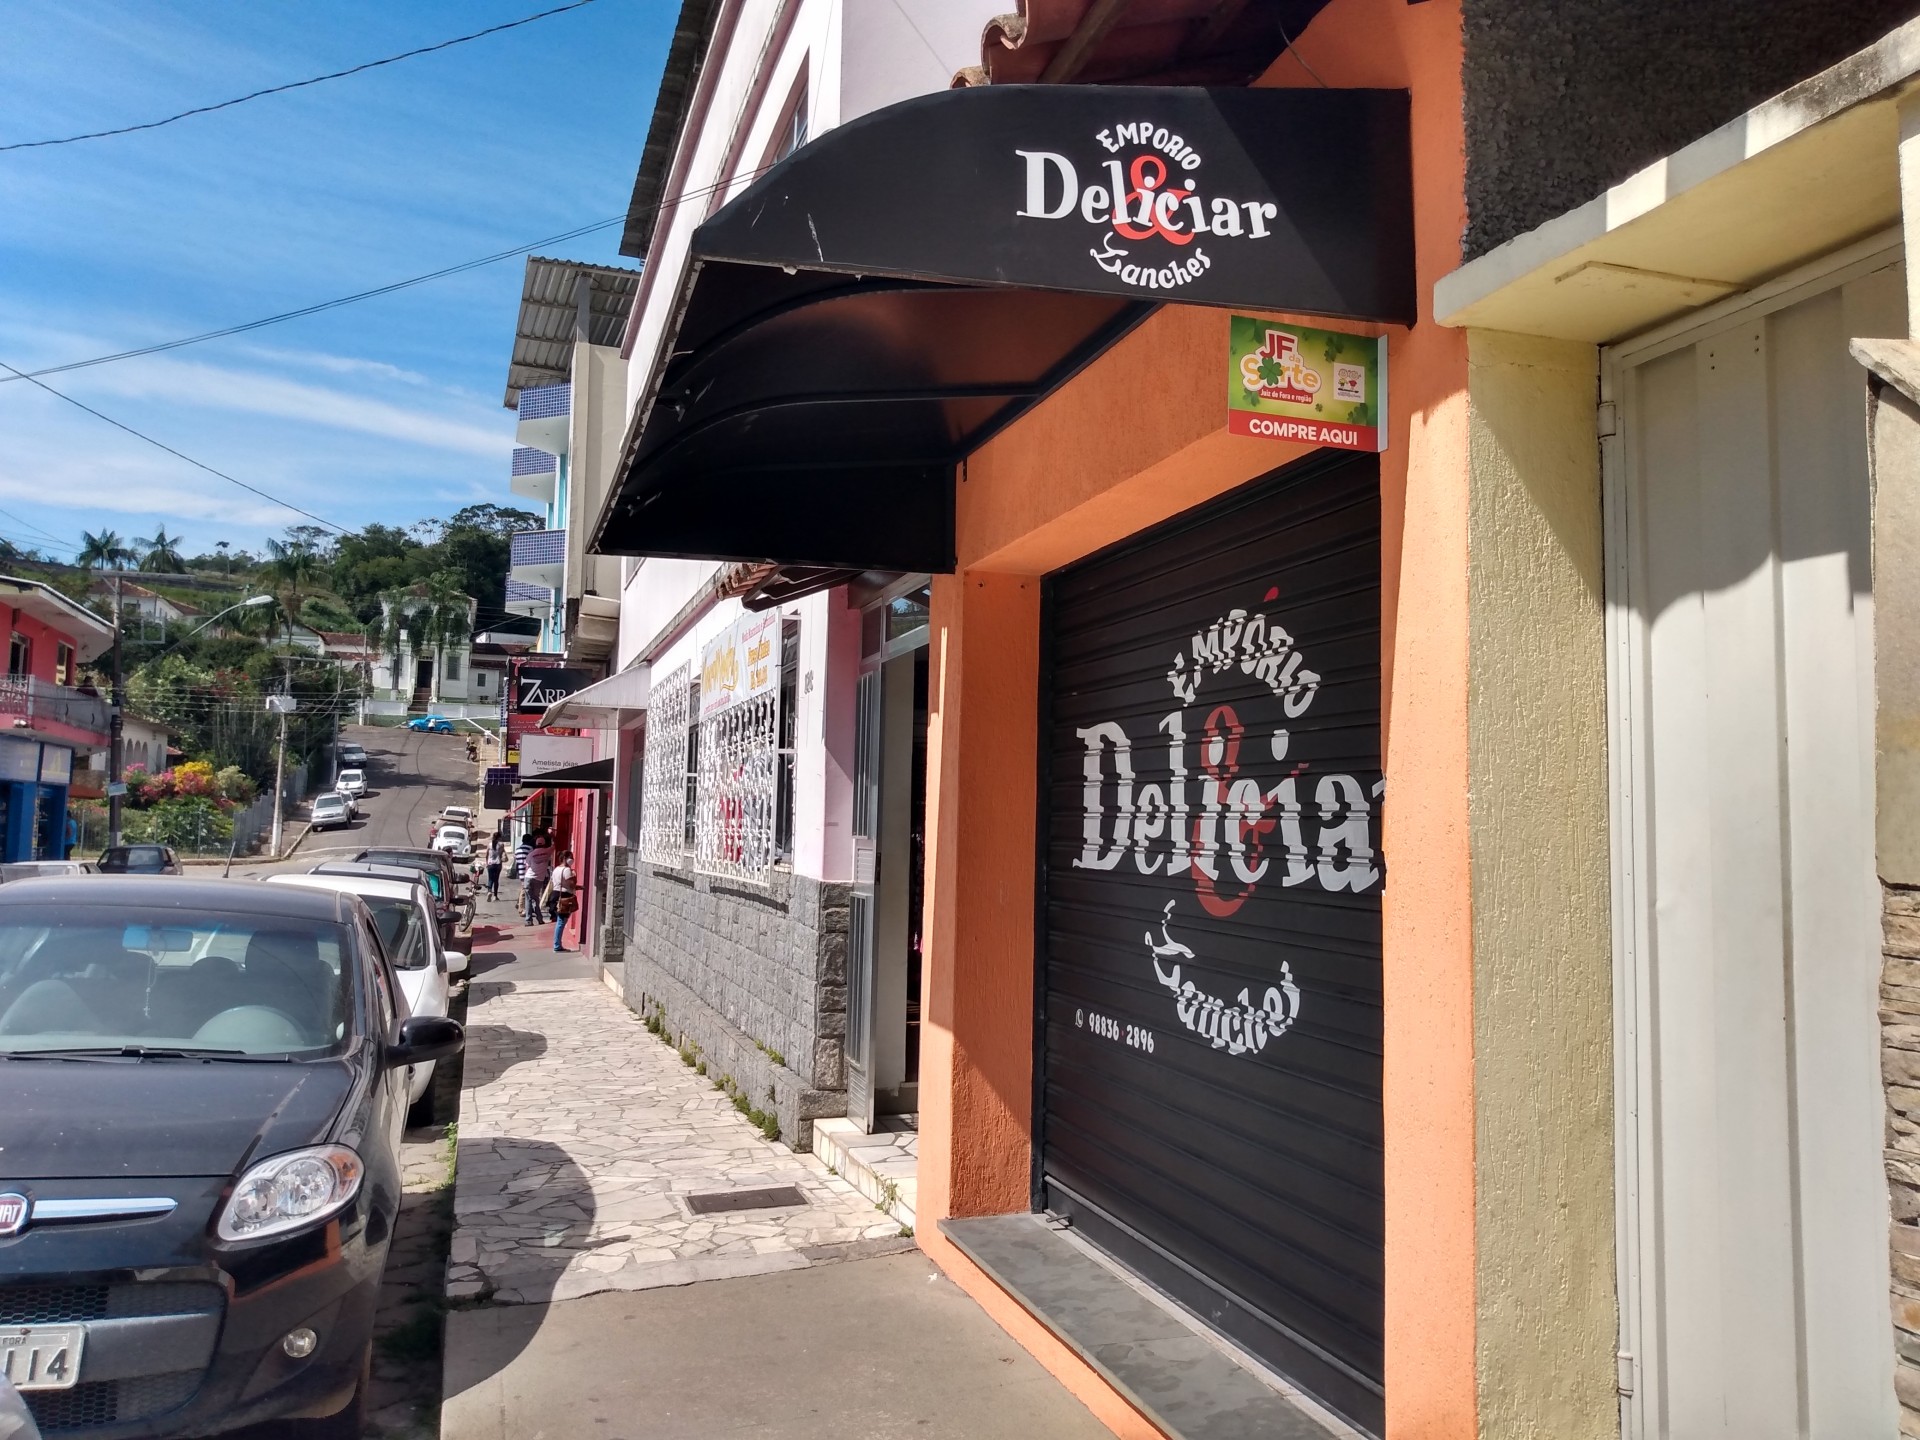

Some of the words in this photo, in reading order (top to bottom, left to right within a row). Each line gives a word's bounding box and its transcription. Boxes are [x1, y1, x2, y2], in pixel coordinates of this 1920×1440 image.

[1096, 122, 1201, 171] EMPORIO
[1015, 150, 1277, 240] Deliciar
[1089, 231, 1210, 289] Lanches
[1260, 333, 1295, 359] JF
[1289, 354, 1300, 362] da
[1243, 357, 1318, 388] Srte
[1260, 389, 1271, 397] Juiz
[1279, 391, 1290, 400] Fora
[1249, 419, 1317, 440] COMPRE
[1318, 428, 1358, 445] AQUI
[520, 676, 578, 706] ZARR
[532, 759, 561, 767] Ametista
[1072, 711, 1387, 893] Delicia
[2, 1337, 27, 1345] FORA
